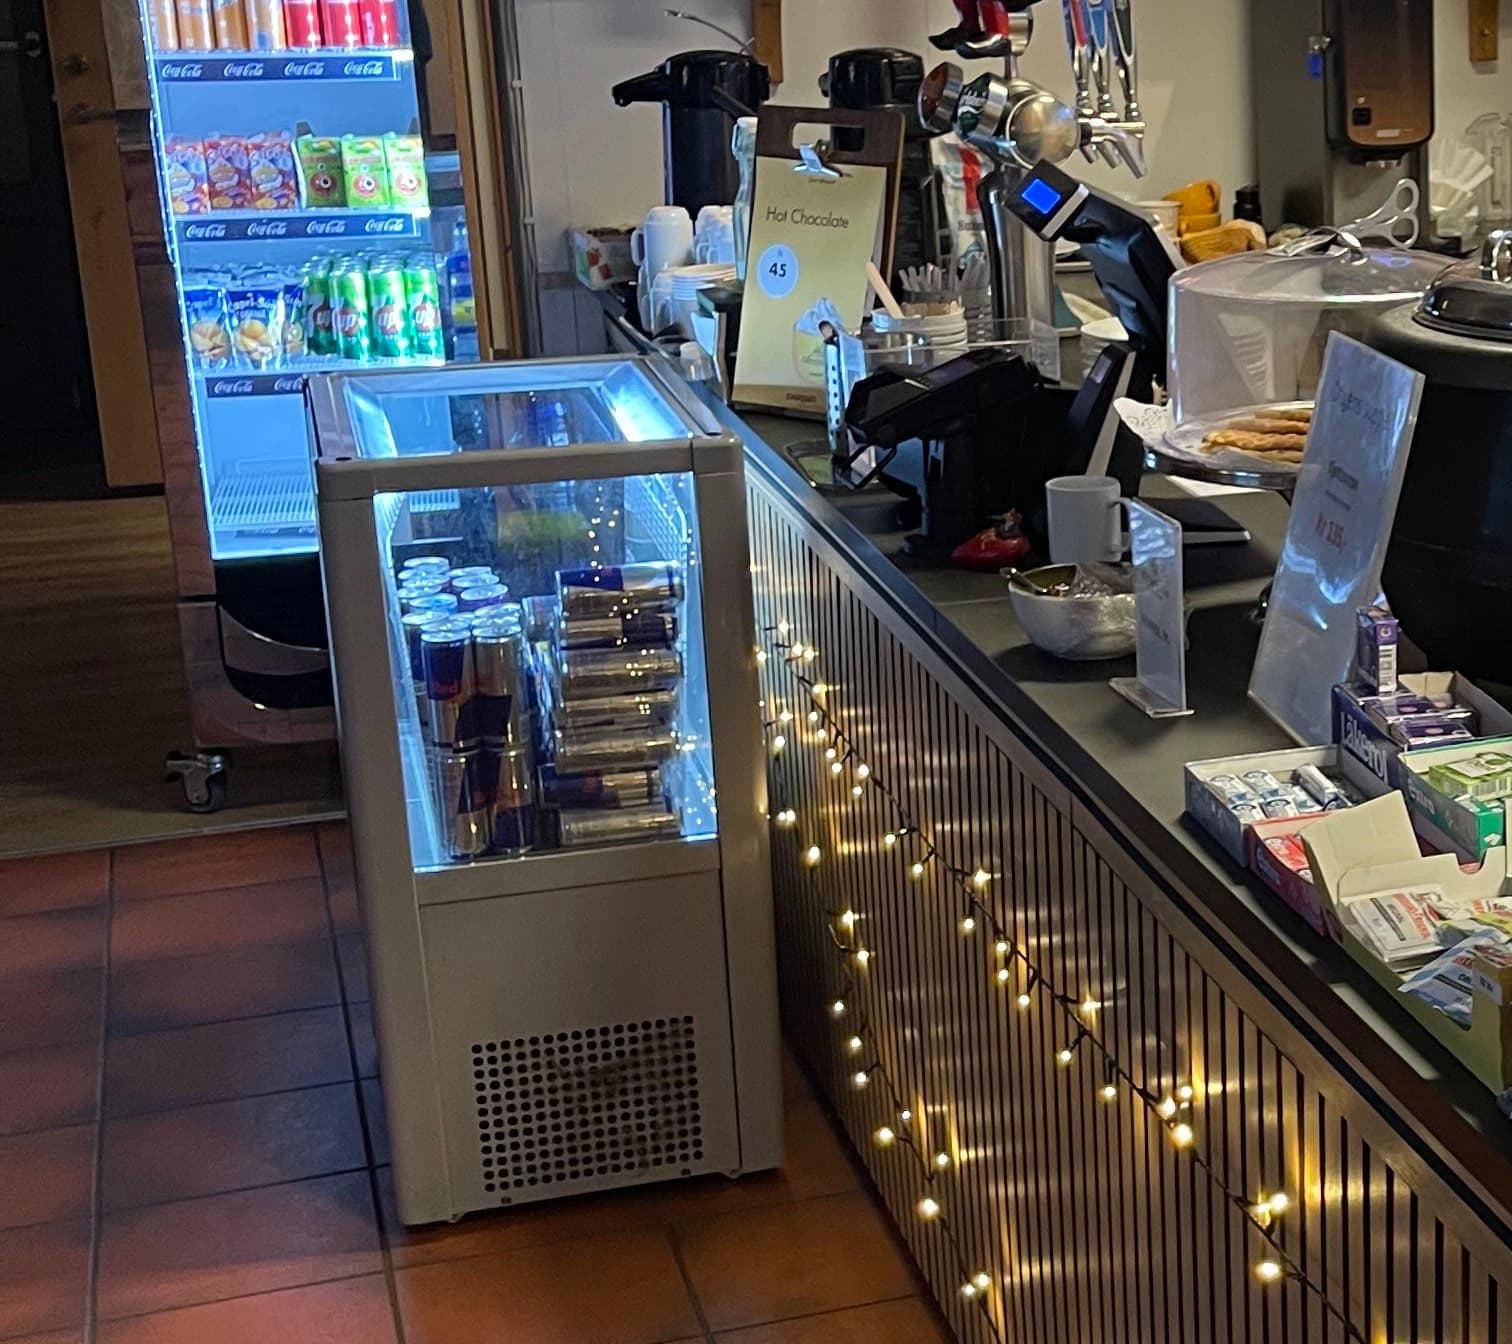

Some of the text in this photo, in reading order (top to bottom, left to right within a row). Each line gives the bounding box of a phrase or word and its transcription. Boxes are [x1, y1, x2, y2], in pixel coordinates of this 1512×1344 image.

[766, 206, 849, 229] Hot Chocolate
[768, 262, 787, 278] 45
